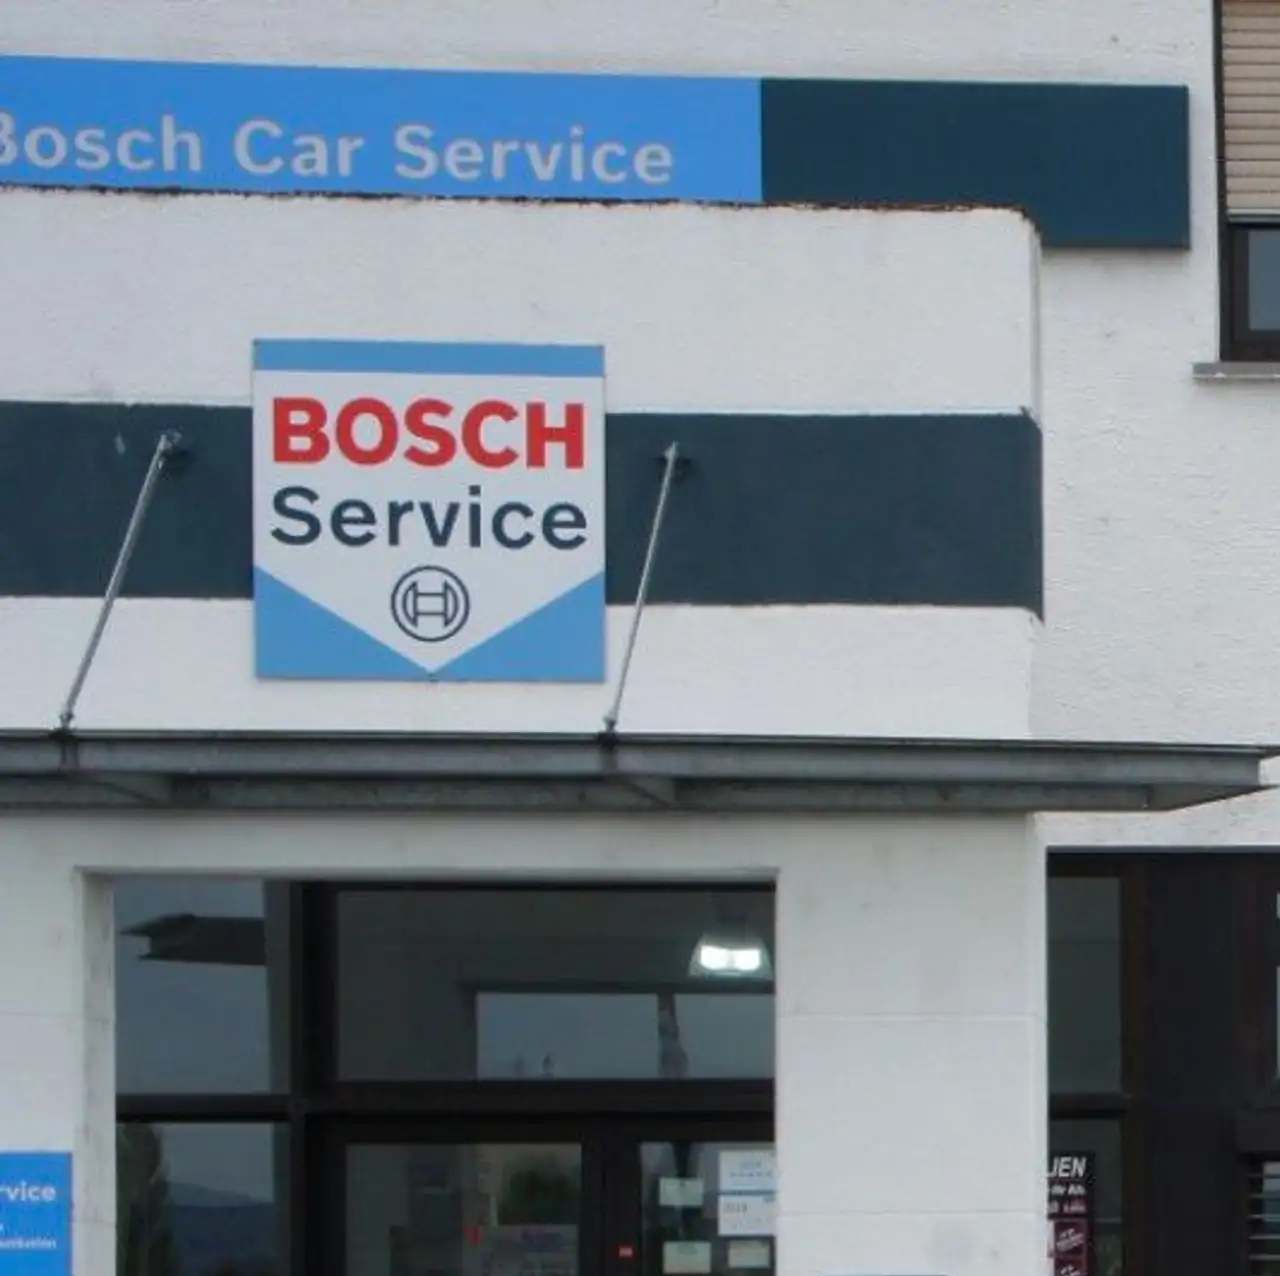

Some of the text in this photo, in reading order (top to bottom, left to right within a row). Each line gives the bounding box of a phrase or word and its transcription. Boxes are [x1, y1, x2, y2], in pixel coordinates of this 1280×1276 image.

[232, 118, 365, 178] Car
[394, 124, 674, 184] Service
[271, 396, 586, 470] BOSCH
[269, 485, 589, 551] Service
